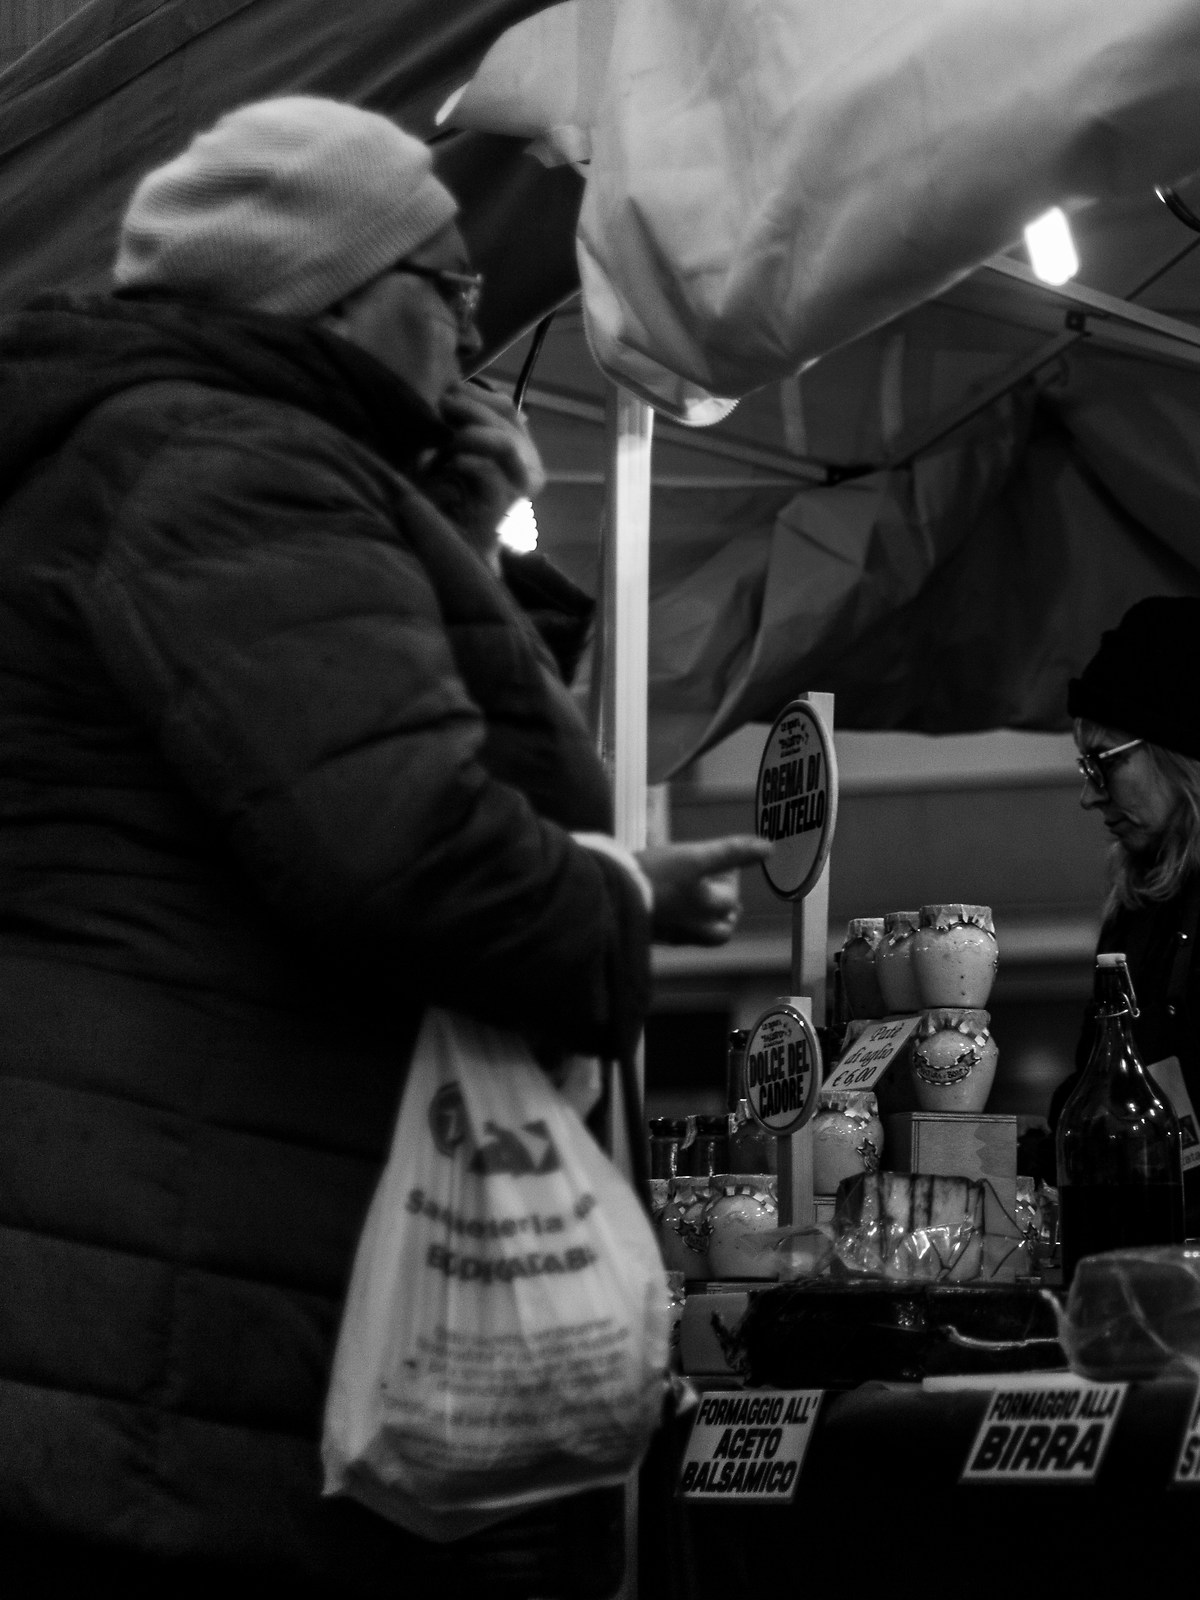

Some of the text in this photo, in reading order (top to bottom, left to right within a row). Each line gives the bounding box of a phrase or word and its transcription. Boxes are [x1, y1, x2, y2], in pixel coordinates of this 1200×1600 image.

[762, 752, 821, 806] CREMA DI
[761, 789, 825, 842] CULATELLO
[749, 1039, 810, 1088] DOLCE DEL
[844, 1042, 894, 1067] di aglio
[760, 1075, 804, 1119] CADORE
[697, 1396, 818, 1425] FORMAGGIO ALL'
[988, 1389, 1121, 1421] FORMAGGIO ALLA
[713, 1427, 783, 1459] ACETO
[970, 1424, 1105, 1471] BIRRA
[681, 1461, 797, 1493] BALSAMICO
